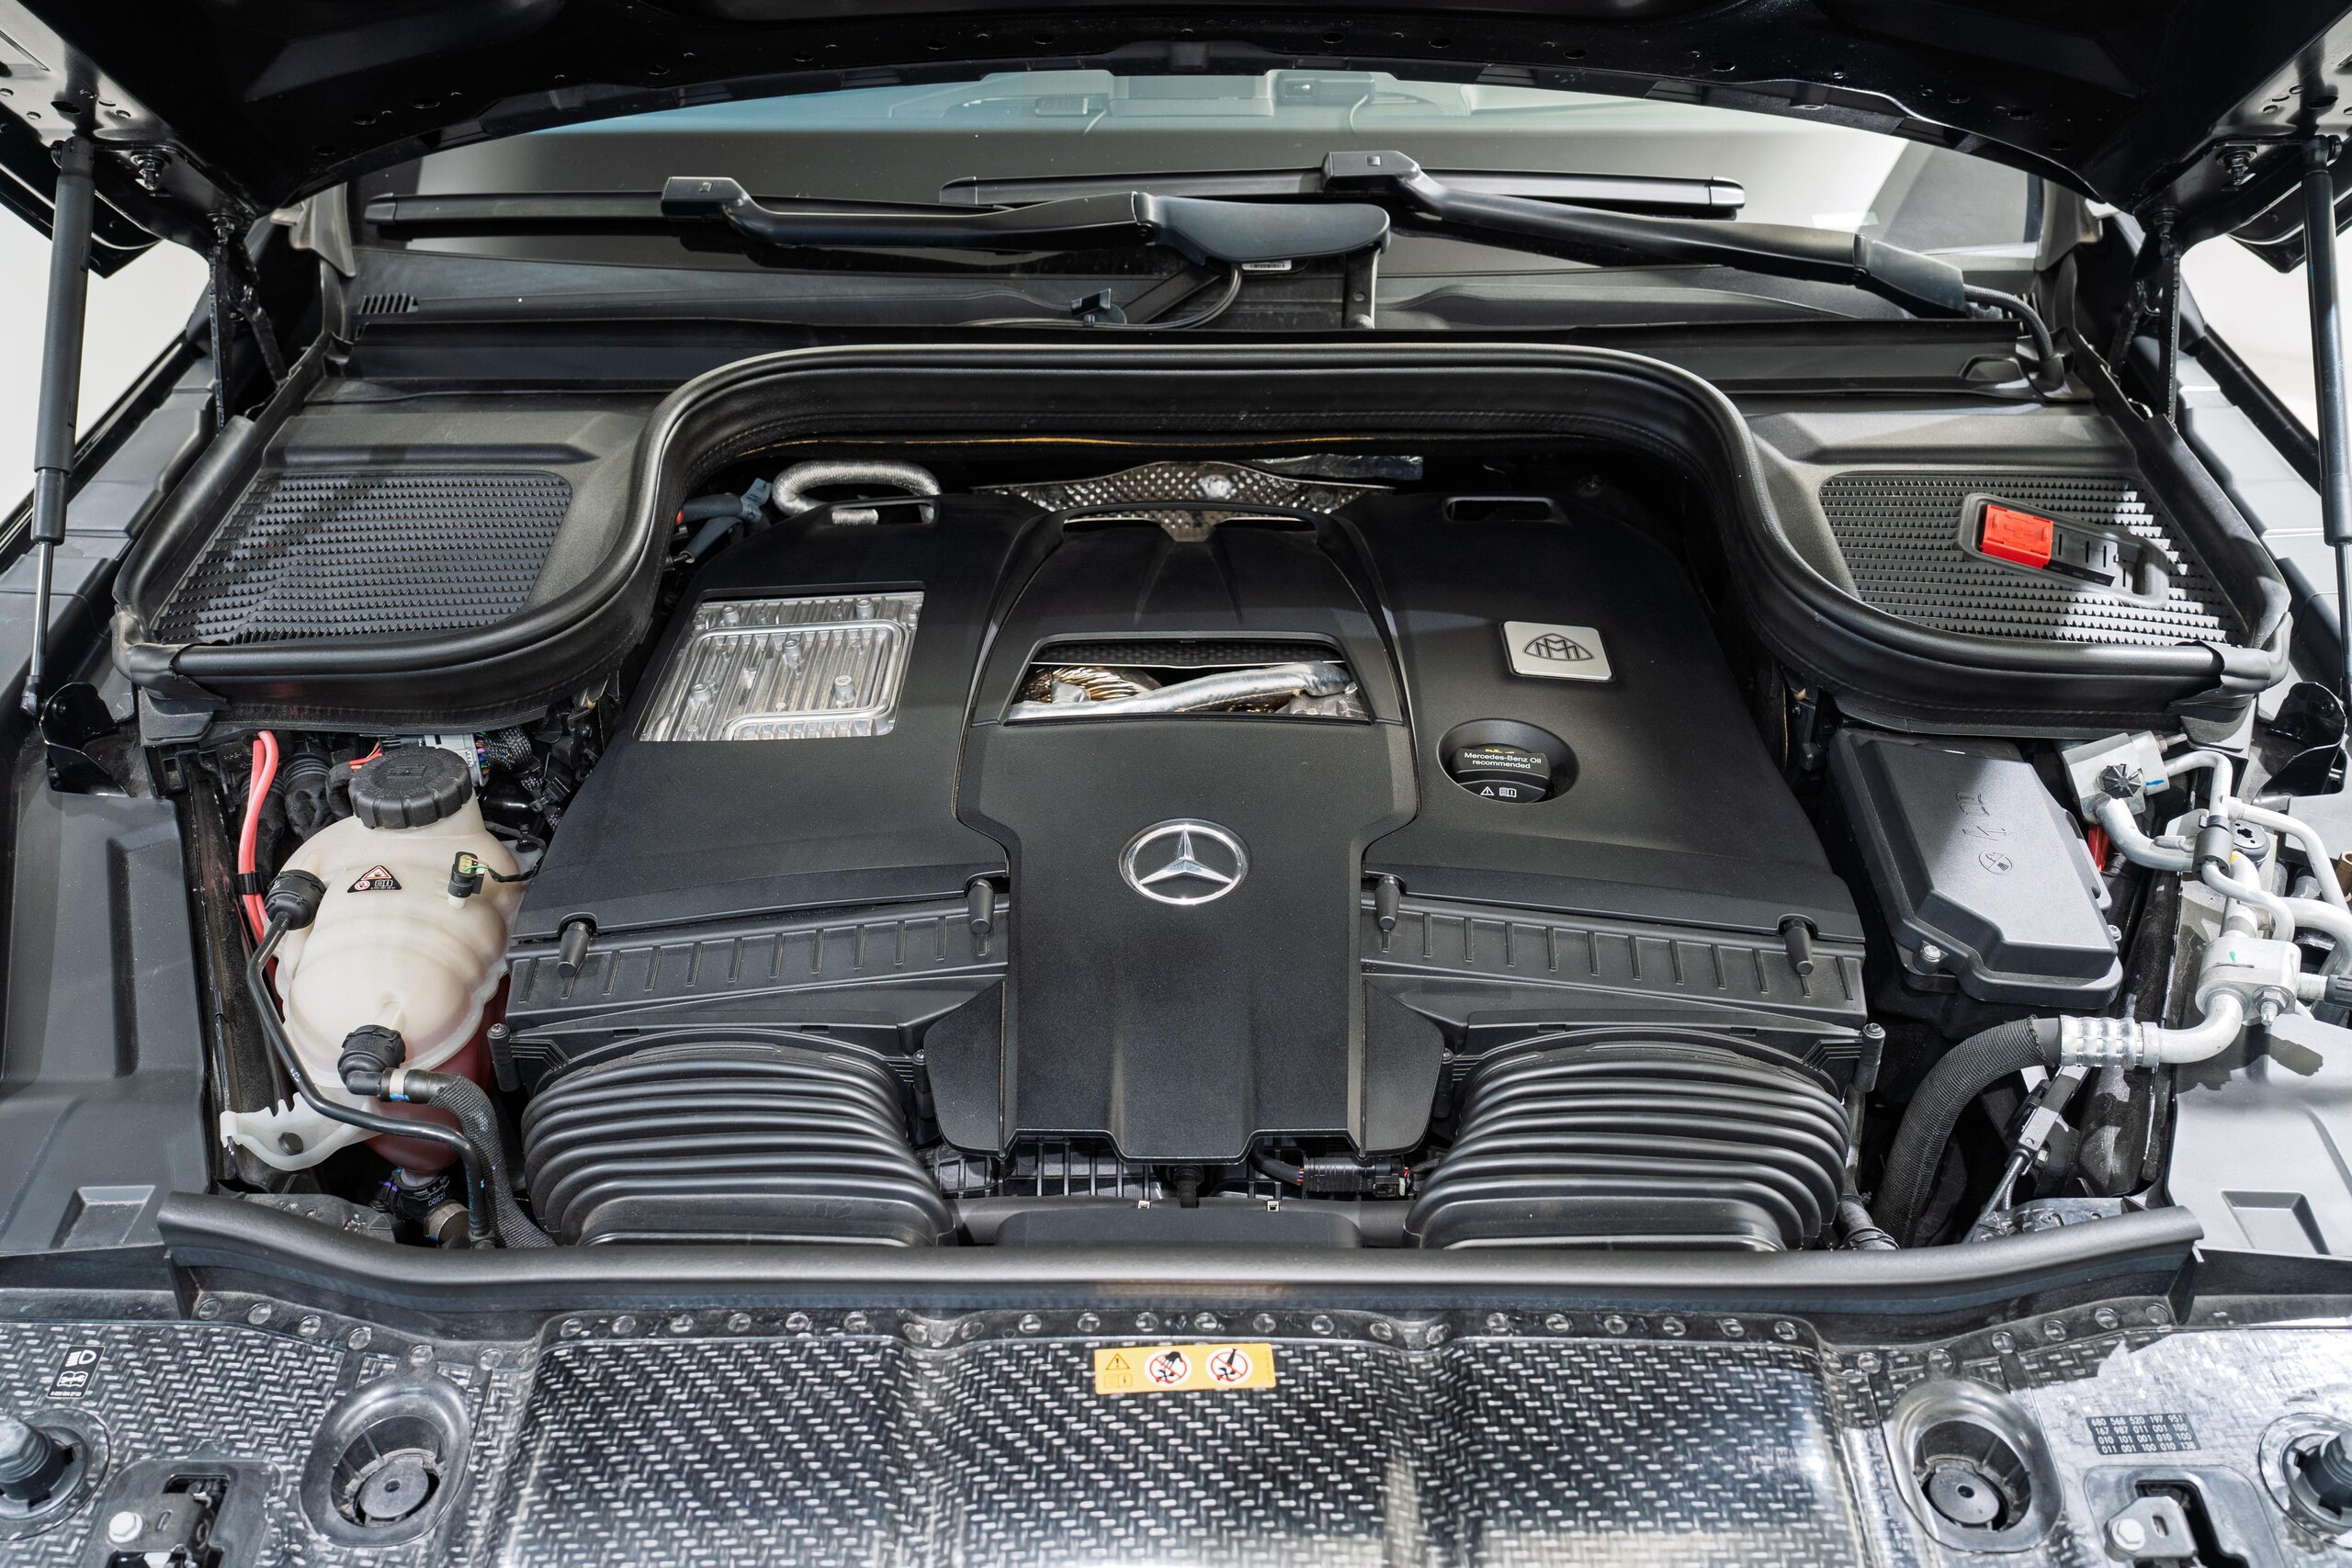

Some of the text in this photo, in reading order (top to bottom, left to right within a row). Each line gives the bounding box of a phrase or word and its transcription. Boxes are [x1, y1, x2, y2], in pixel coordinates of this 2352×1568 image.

[1464, 751, 1528, 763] Mercedes-Benz
[1472, 759, 1531, 769] recommended
[2130, 1416, 2145, 1425] 520
